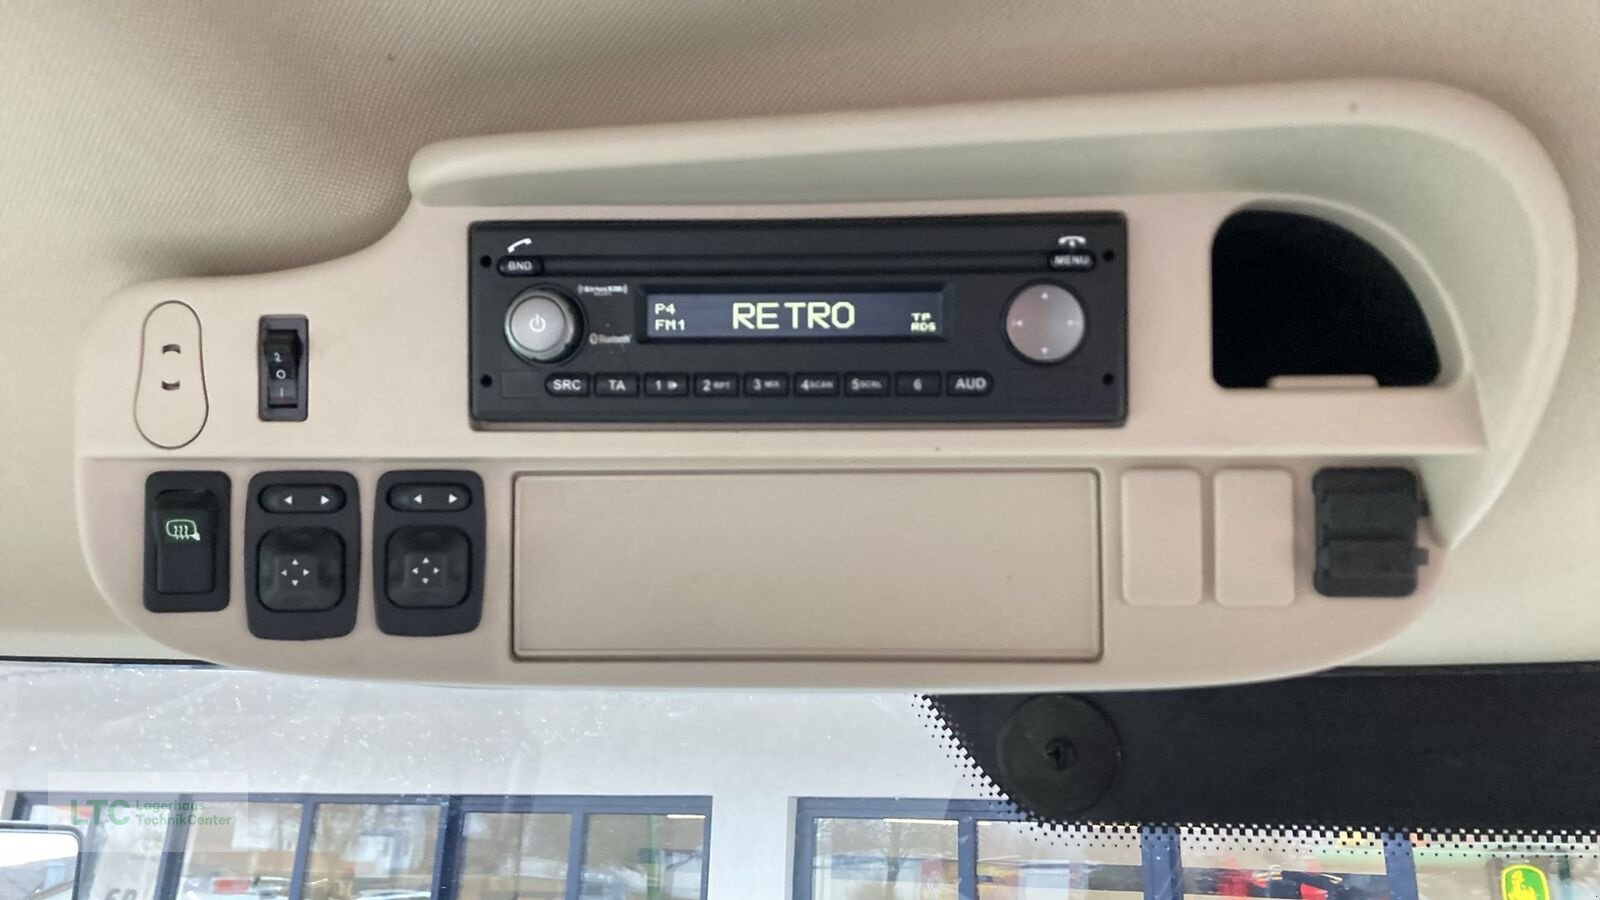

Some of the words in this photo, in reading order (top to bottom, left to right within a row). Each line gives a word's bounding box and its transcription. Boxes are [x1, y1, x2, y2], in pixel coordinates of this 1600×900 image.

[507, 260, 533, 271] BND
[1054, 254, 1091, 266] MENU
[655, 303, 676, 316] P4
[732, 301, 856, 330] RETRO
[911, 312, 932, 321] TP
[655, 319, 686, 331] FM1
[911, 321, 937, 333] RDS
[273, 352, 282, 362] 2
[552, 378, 582, 391] SRC
[608, 379, 627, 391] TA
[655, 379, 662, 391] 1
[702, 378, 712, 392] 2
[752, 377, 762, 391] 3
[912, 377, 923, 391] 6
[954, 376, 987, 391] AUD
